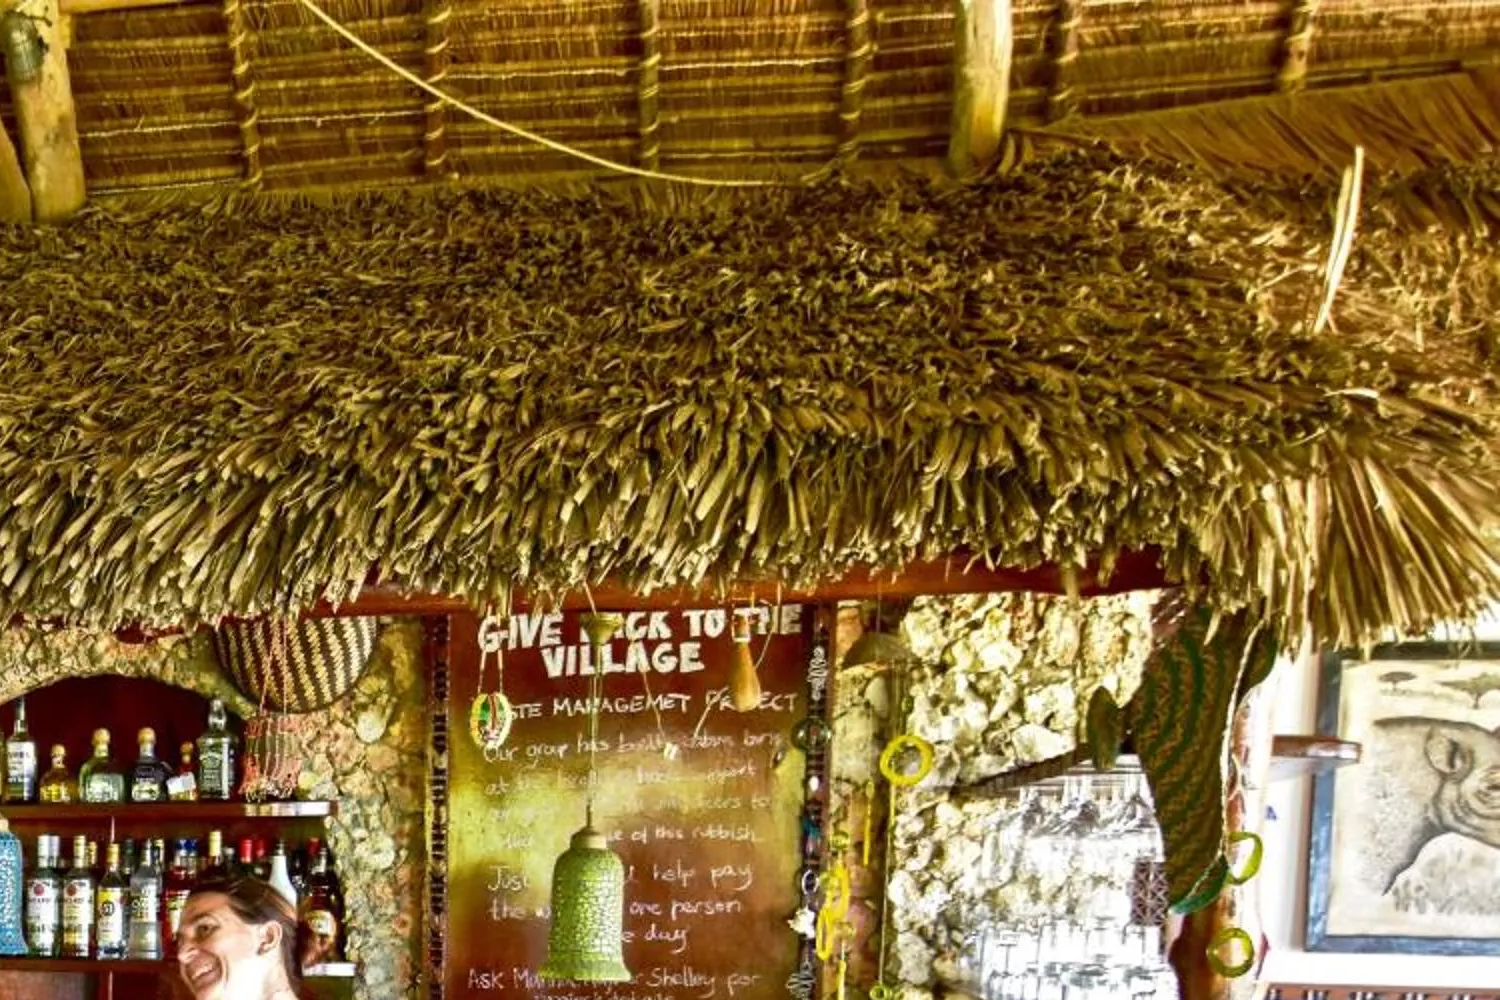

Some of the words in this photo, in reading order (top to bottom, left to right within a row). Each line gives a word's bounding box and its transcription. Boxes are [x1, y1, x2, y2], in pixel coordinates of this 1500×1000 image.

[478, 612, 565, 653] GIVE
[580, 611, 673, 643] CK
[683, 608, 727, 639] TO
[540, 641, 706, 678] VILLAGE
[705, 690, 799, 713] PRECT
[653, 859, 696, 888] help
[711, 863, 753, 891] pay
[671, 898, 742, 922] person
[644, 923, 692, 954] day
[467, 967, 505, 990] Ask
